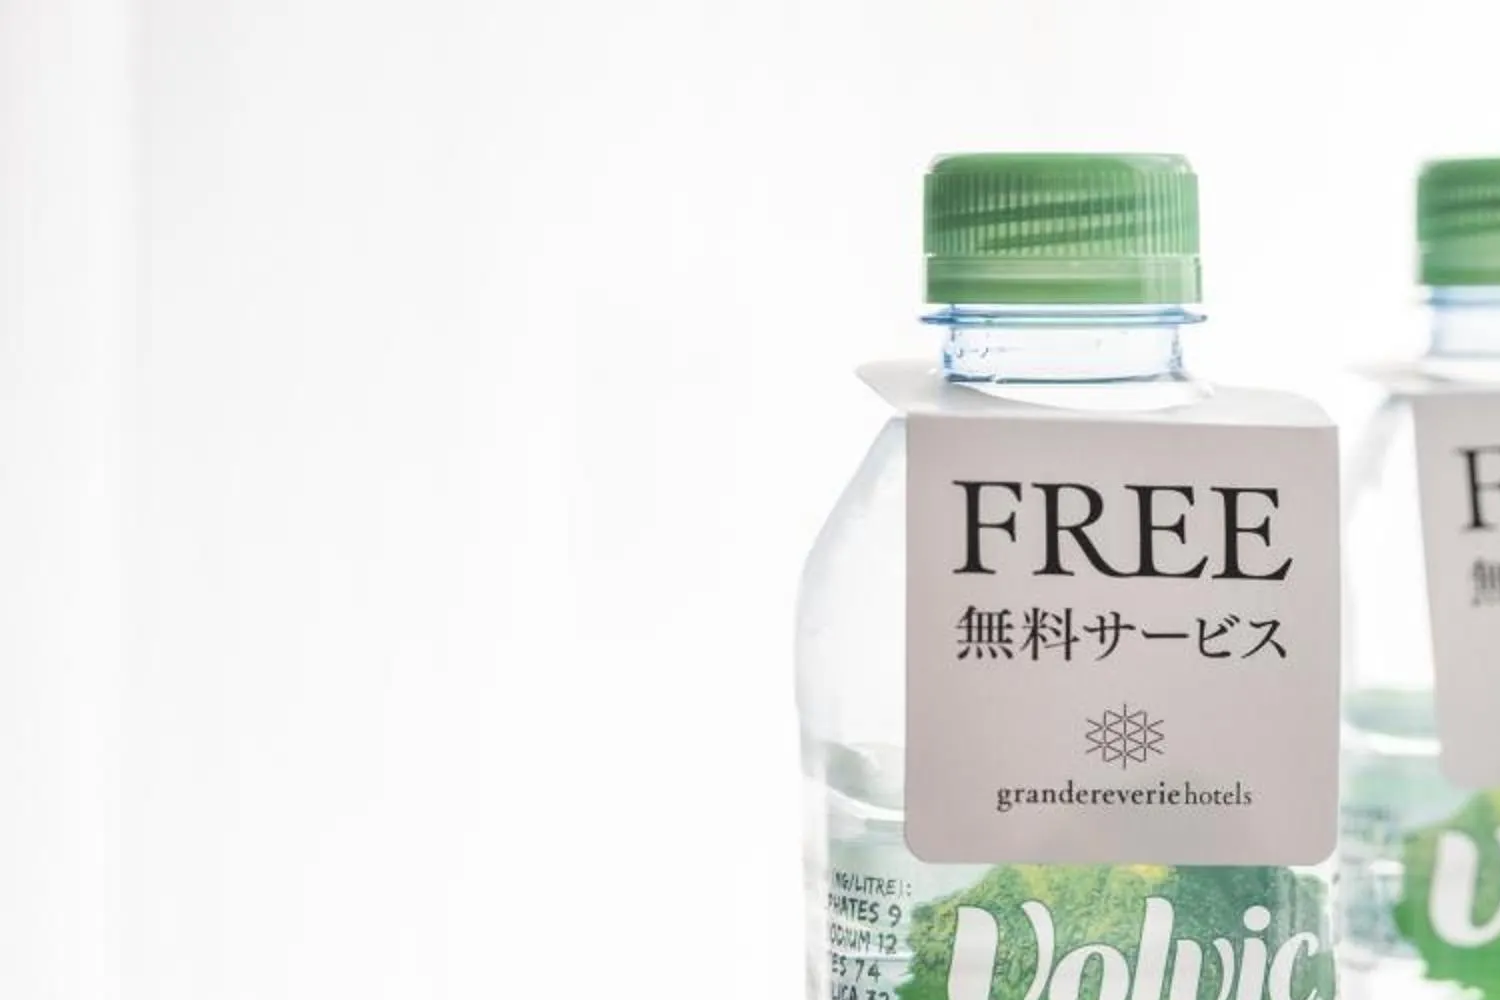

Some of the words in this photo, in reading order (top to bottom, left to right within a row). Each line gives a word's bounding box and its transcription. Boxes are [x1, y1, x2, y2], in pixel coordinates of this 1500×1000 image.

[952, 480, 1292, 581] FREE
[955, 605, 1288, 661] 無料サービス
[888, 903, 902, 928] 9
[878, 932, 897, 955] 12
[855, 960, 881, 983] 74
